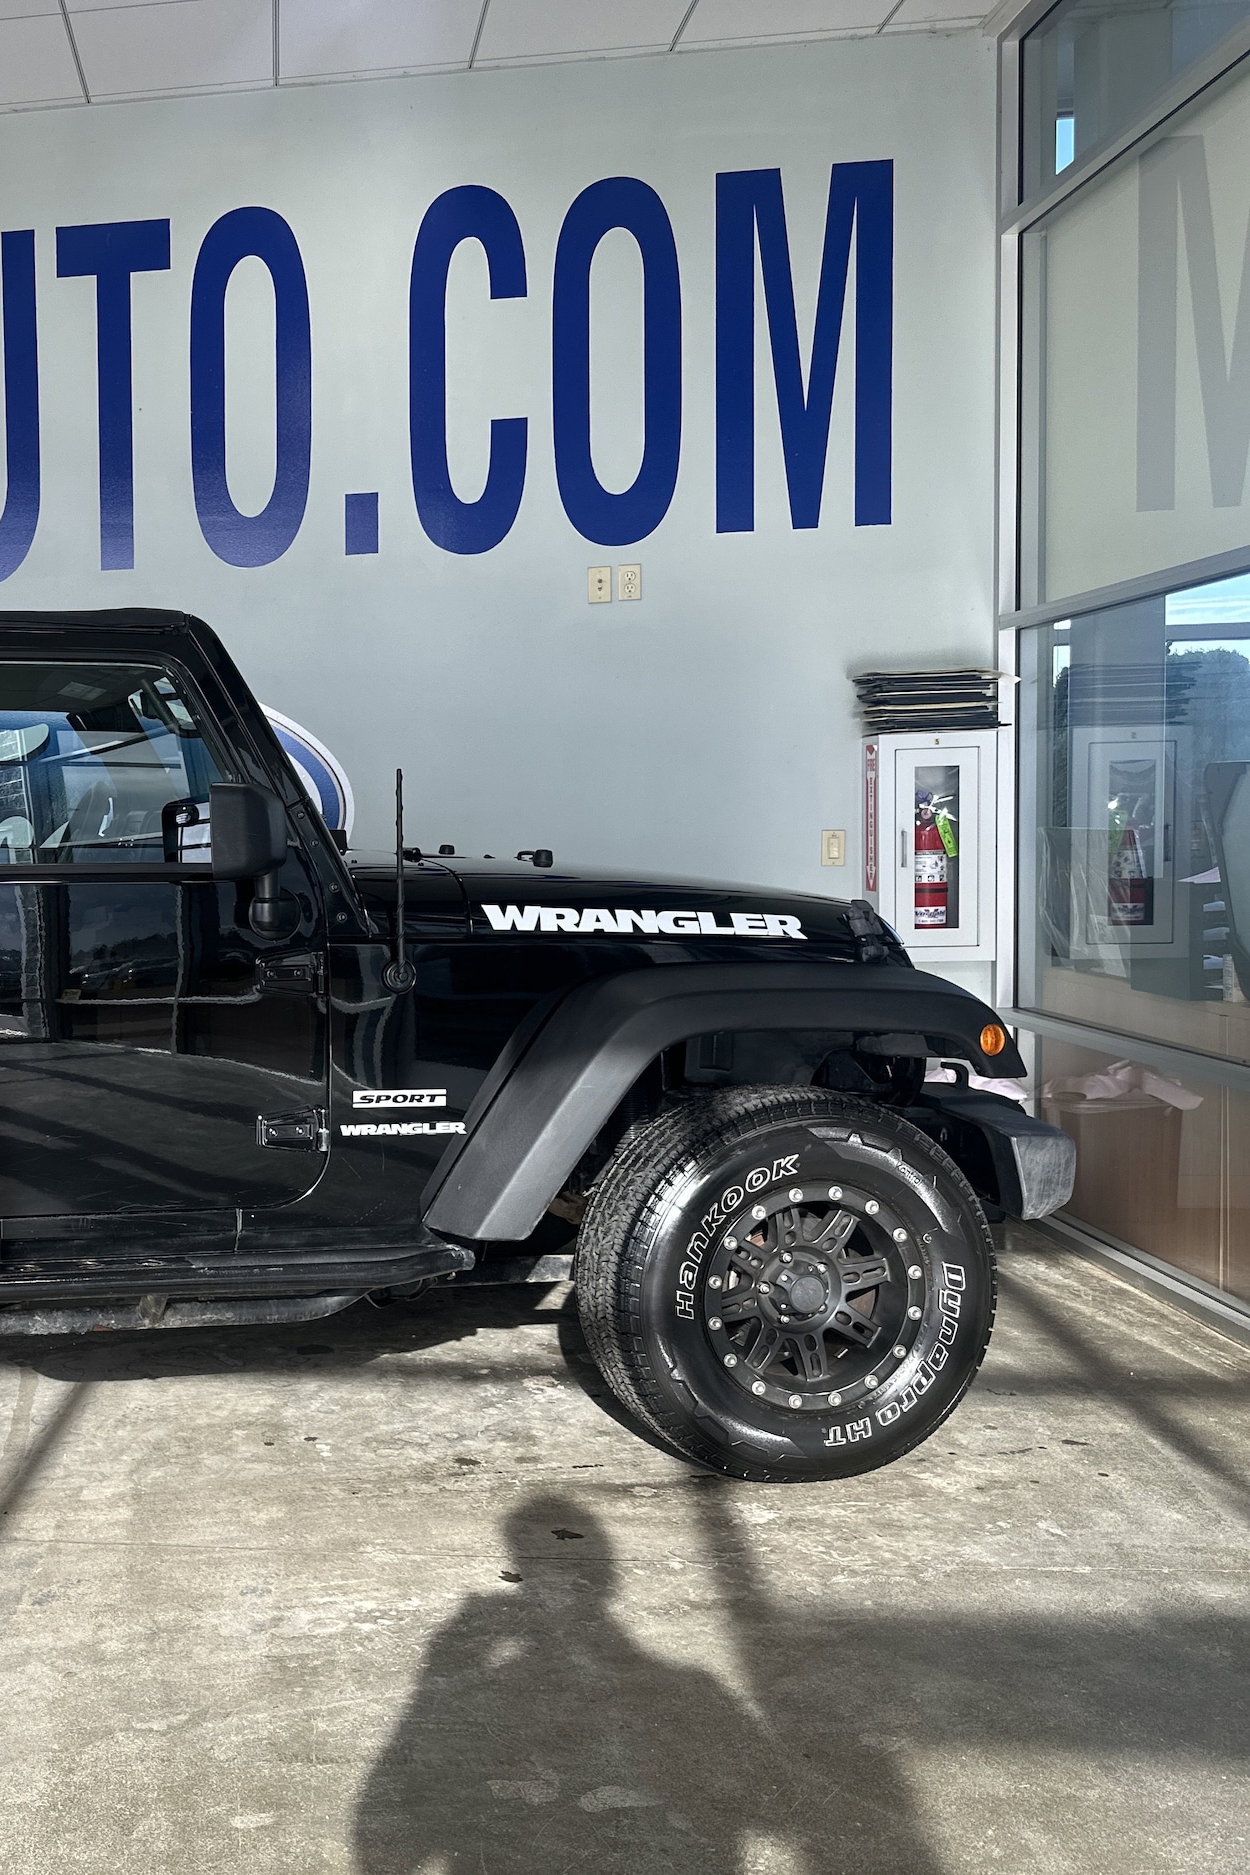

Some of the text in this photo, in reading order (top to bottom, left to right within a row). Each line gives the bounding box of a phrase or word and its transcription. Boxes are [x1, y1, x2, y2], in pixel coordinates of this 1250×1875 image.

[481, 904, 808, 939] WRANGLER
[353, 1092, 447, 1105] SPORT
[340, 1121, 467, 1136] WRANGLER
[876, 1262, 966, 1427] Dynapro
[824, 1417, 873, 1447] HT
